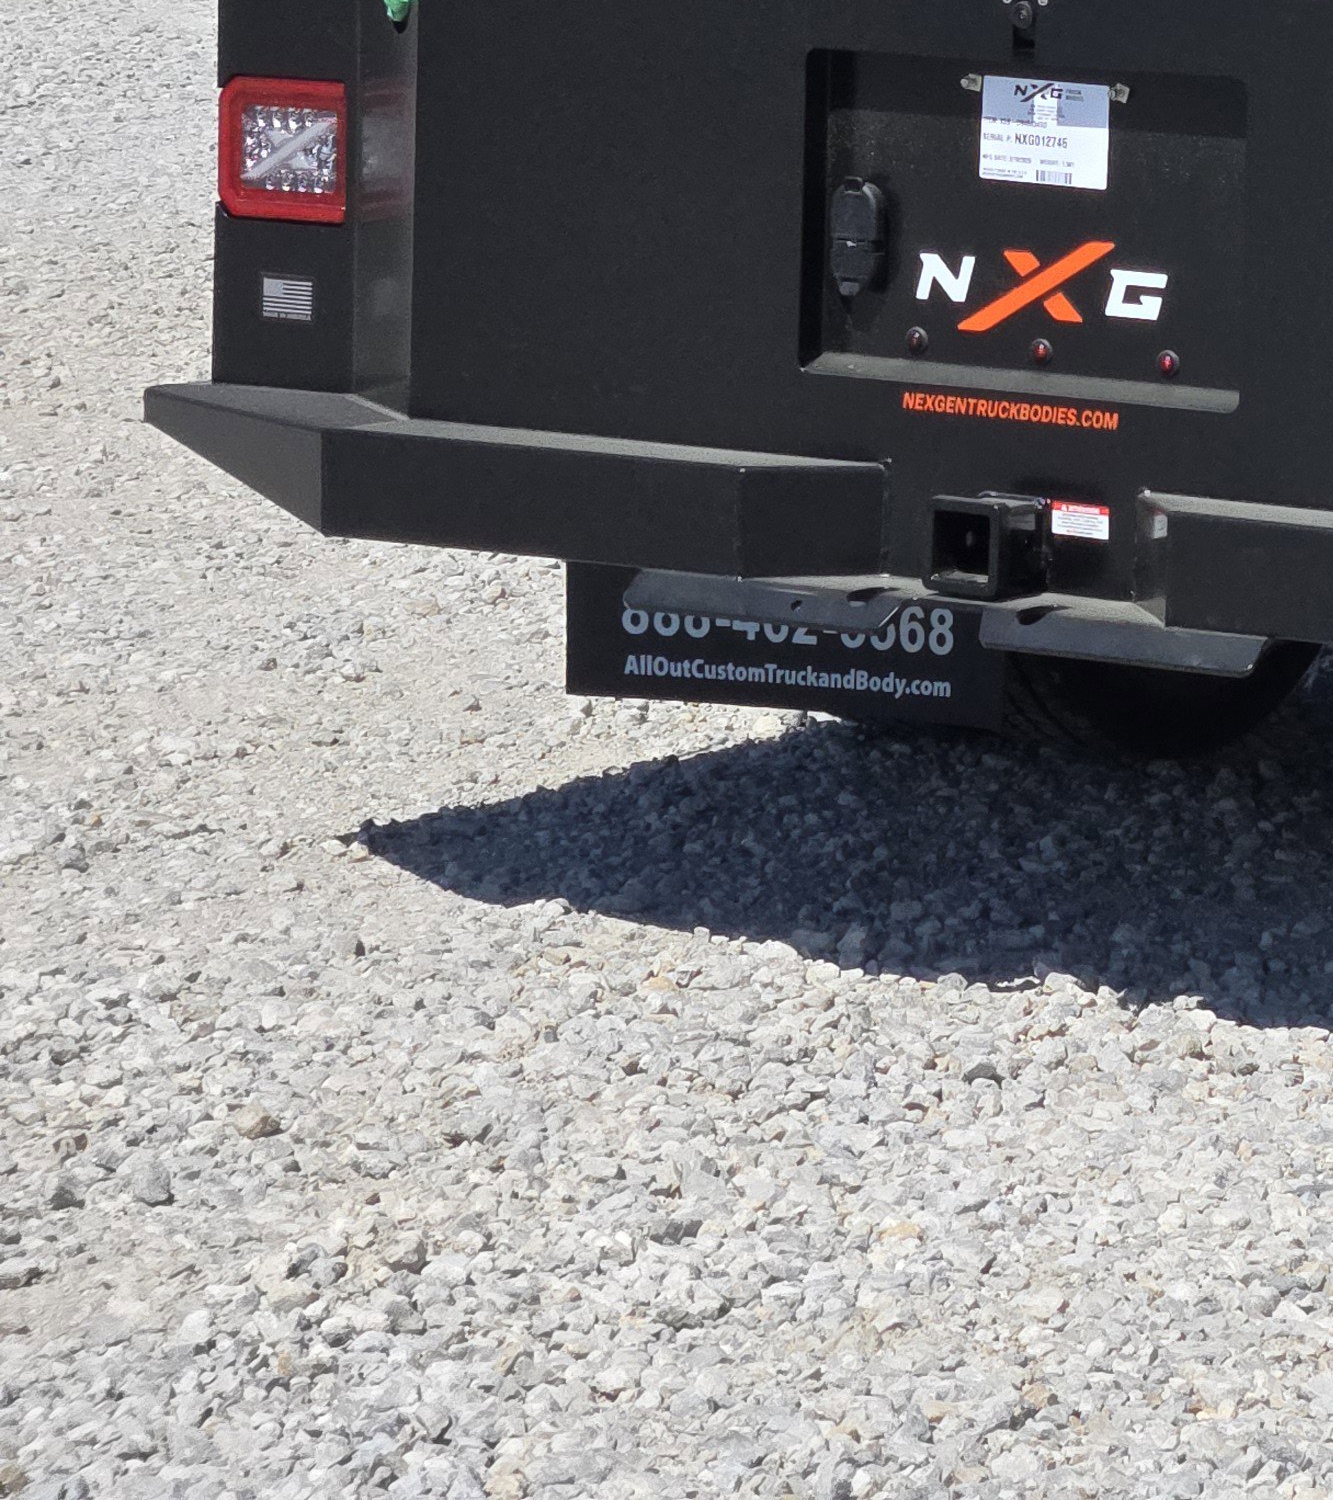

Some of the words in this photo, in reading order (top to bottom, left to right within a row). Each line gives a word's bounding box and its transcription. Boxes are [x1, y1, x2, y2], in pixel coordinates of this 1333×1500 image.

[1013, 82, 1064, 103] NXG
[915, 240, 1169, 332] NXG
[901, 391, 1120, 431] NEXGENTRUCKBODIES.COM
[624, 654, 952, 699] AllOutCustomTruckandBody.com
